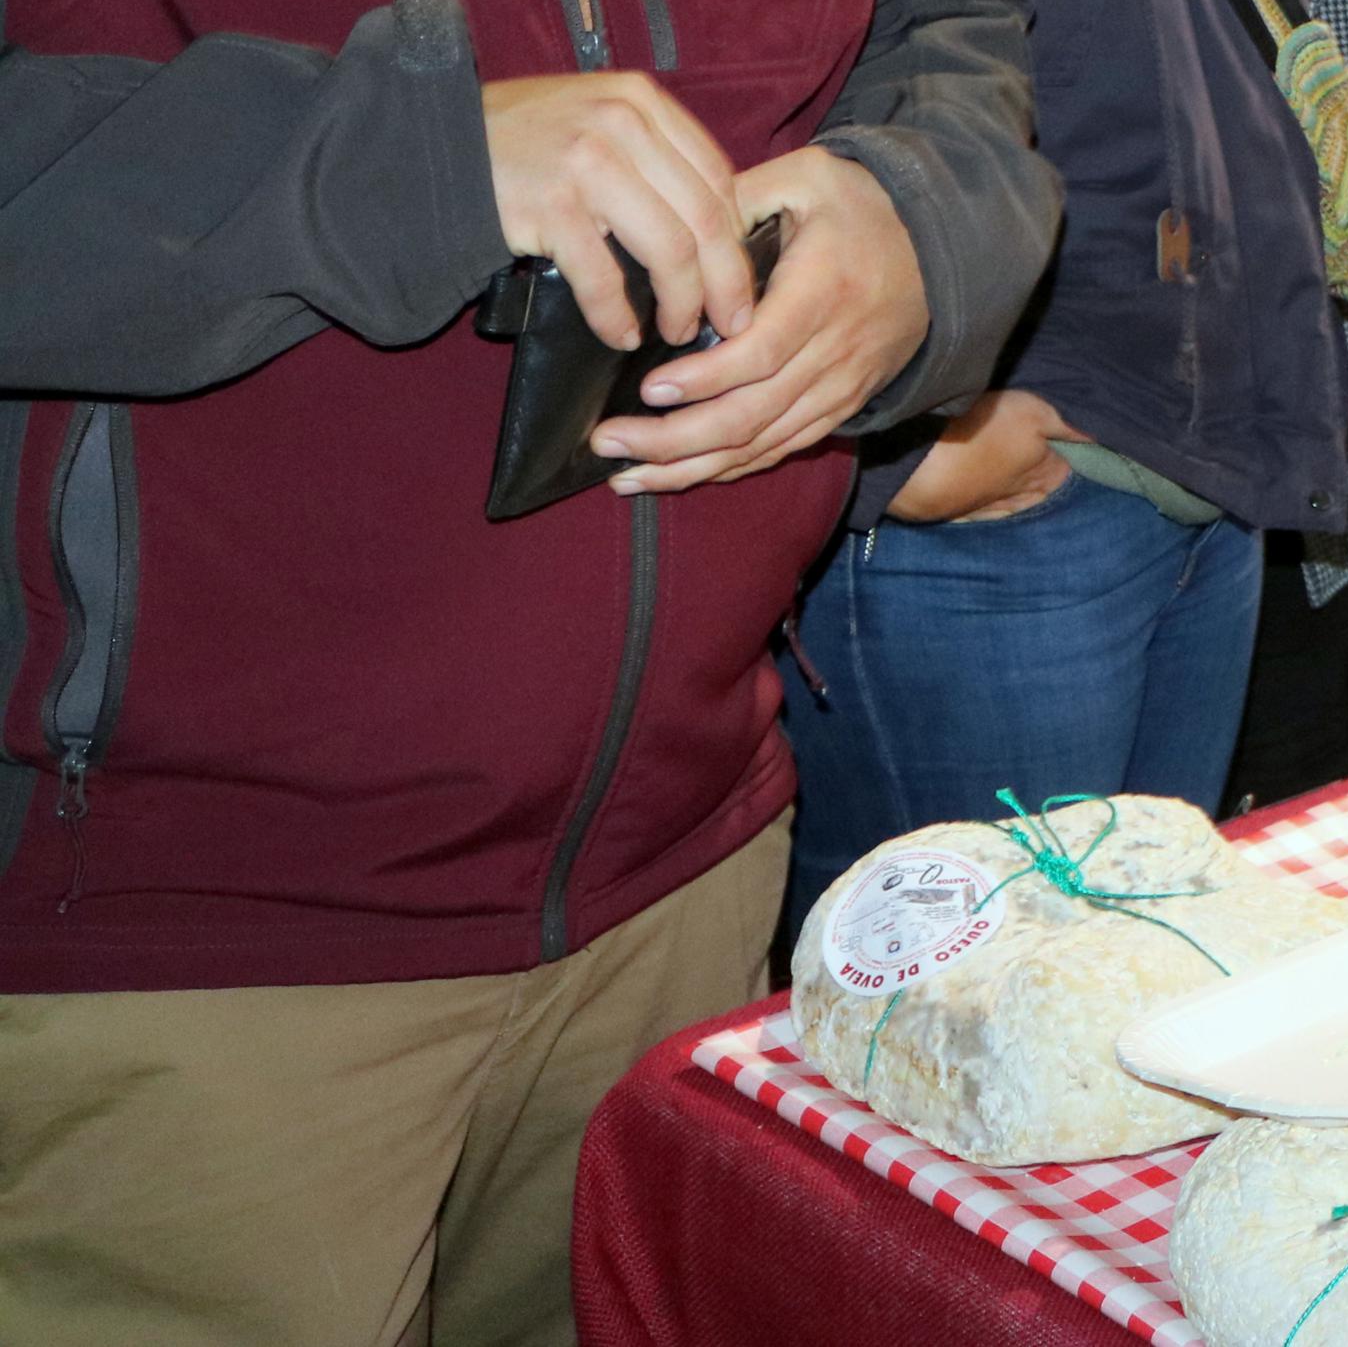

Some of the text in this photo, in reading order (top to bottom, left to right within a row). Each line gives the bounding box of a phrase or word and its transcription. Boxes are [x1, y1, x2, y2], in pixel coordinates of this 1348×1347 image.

[839, 920, 990, 989] QUESO DE OVEJA
